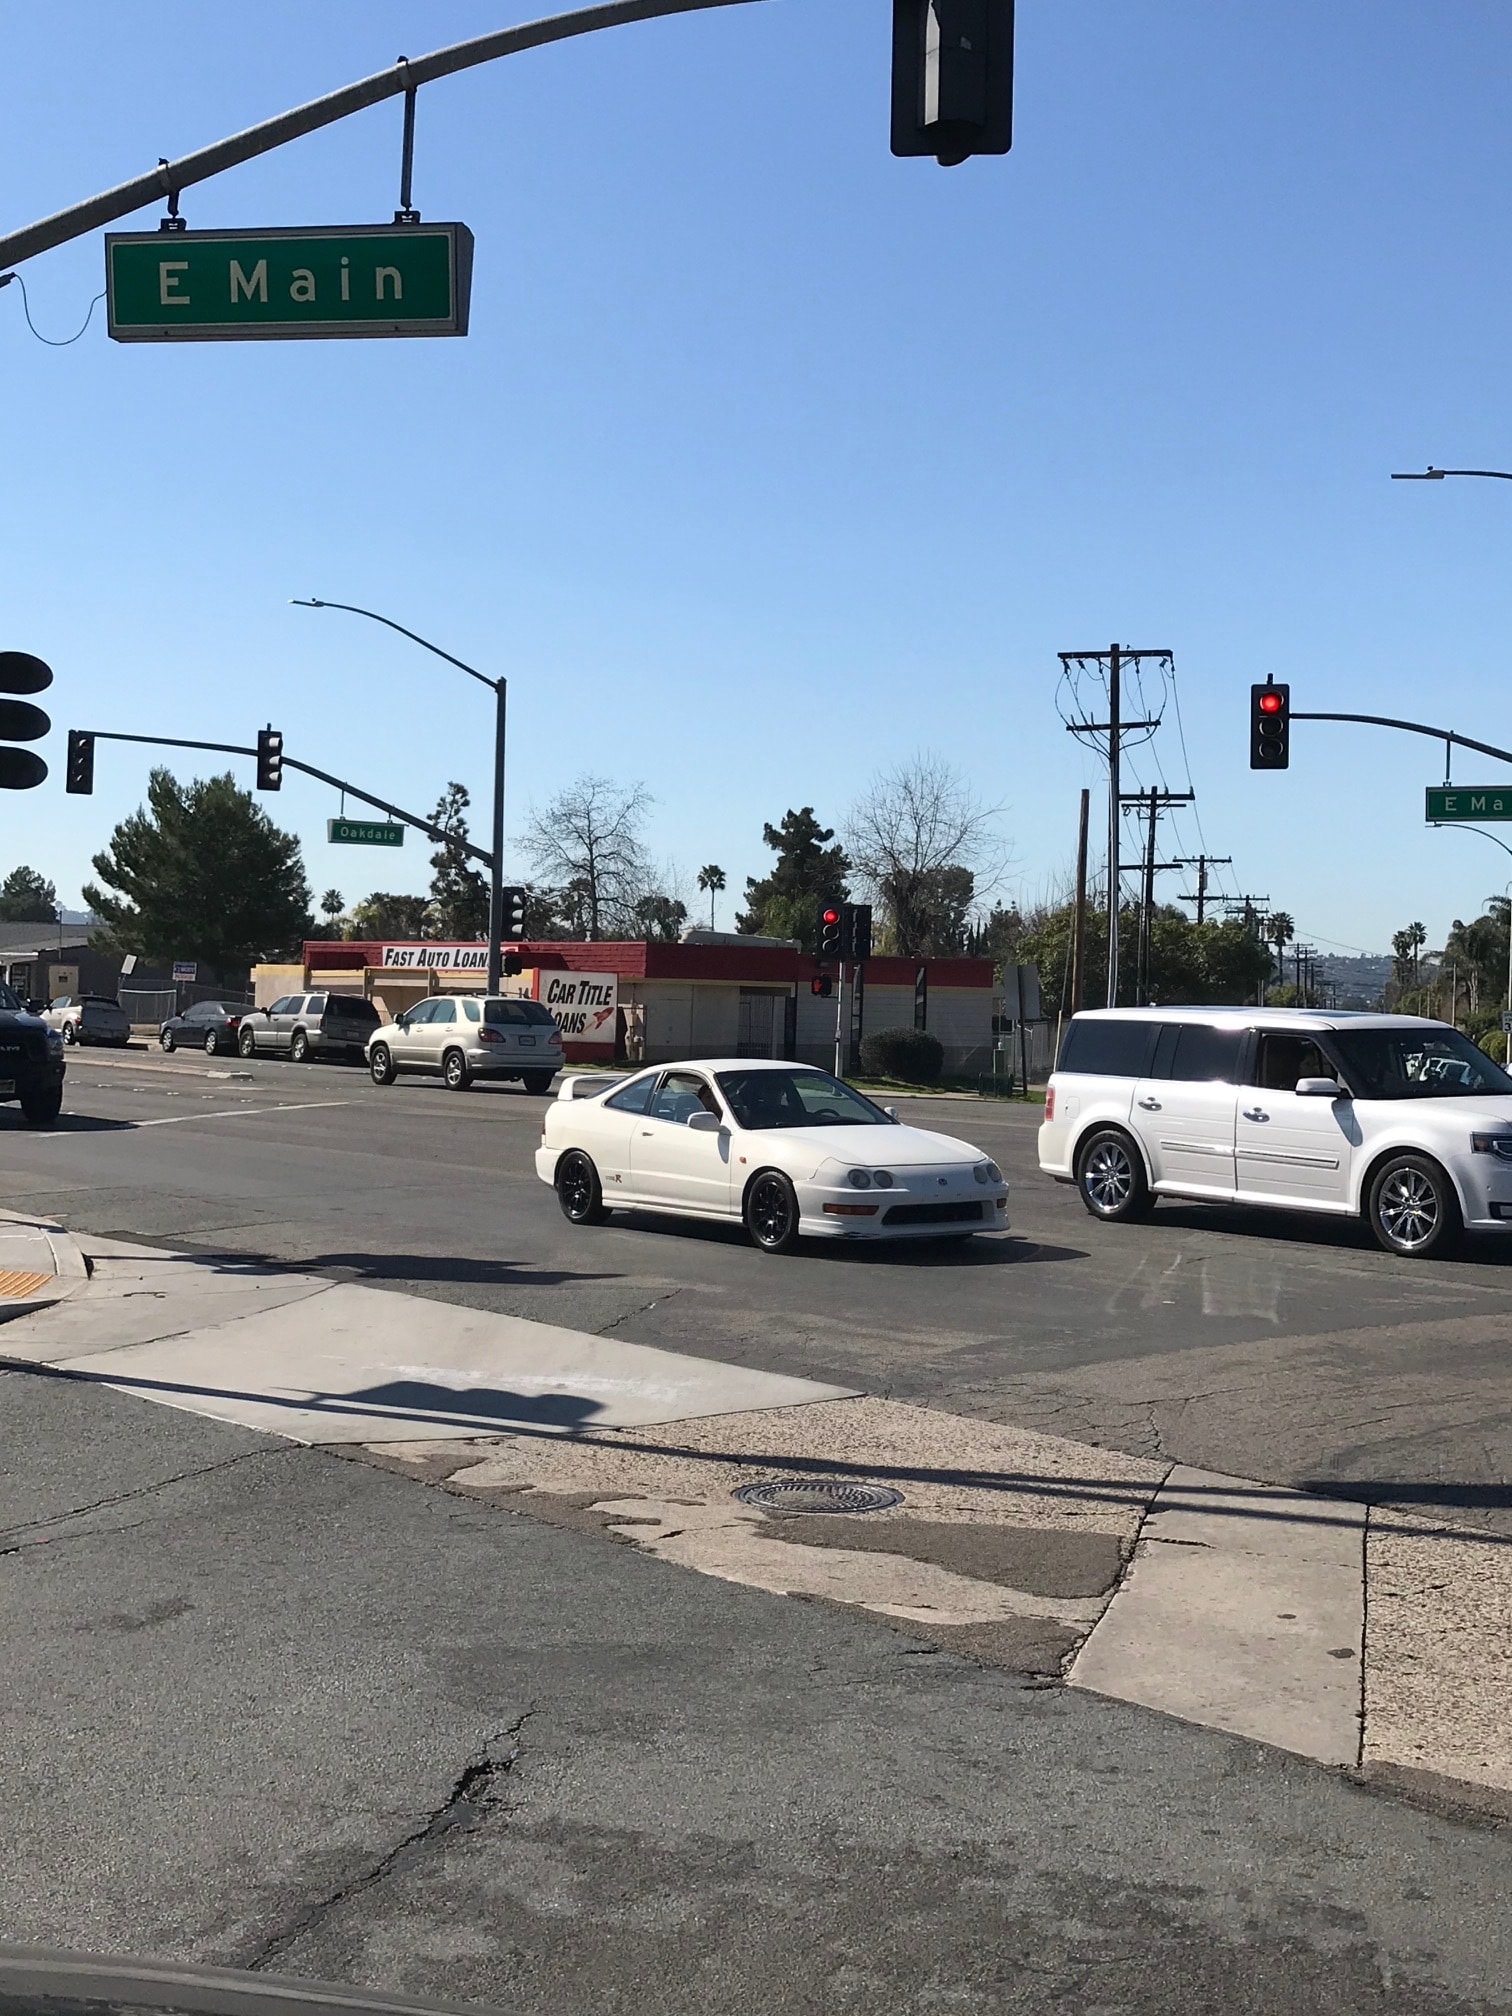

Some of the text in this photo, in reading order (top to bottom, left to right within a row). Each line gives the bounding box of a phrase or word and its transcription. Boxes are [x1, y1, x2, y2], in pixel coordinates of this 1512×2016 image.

[159, 256, 403, 305] E Main
[1445, 796, 1457, 811] E
[340, 826, 396, 840] Oakdale
[384, 948, 490, 968] FAST AUTO LOAN
[547, 979, 614, 1006] CAR TITLE
